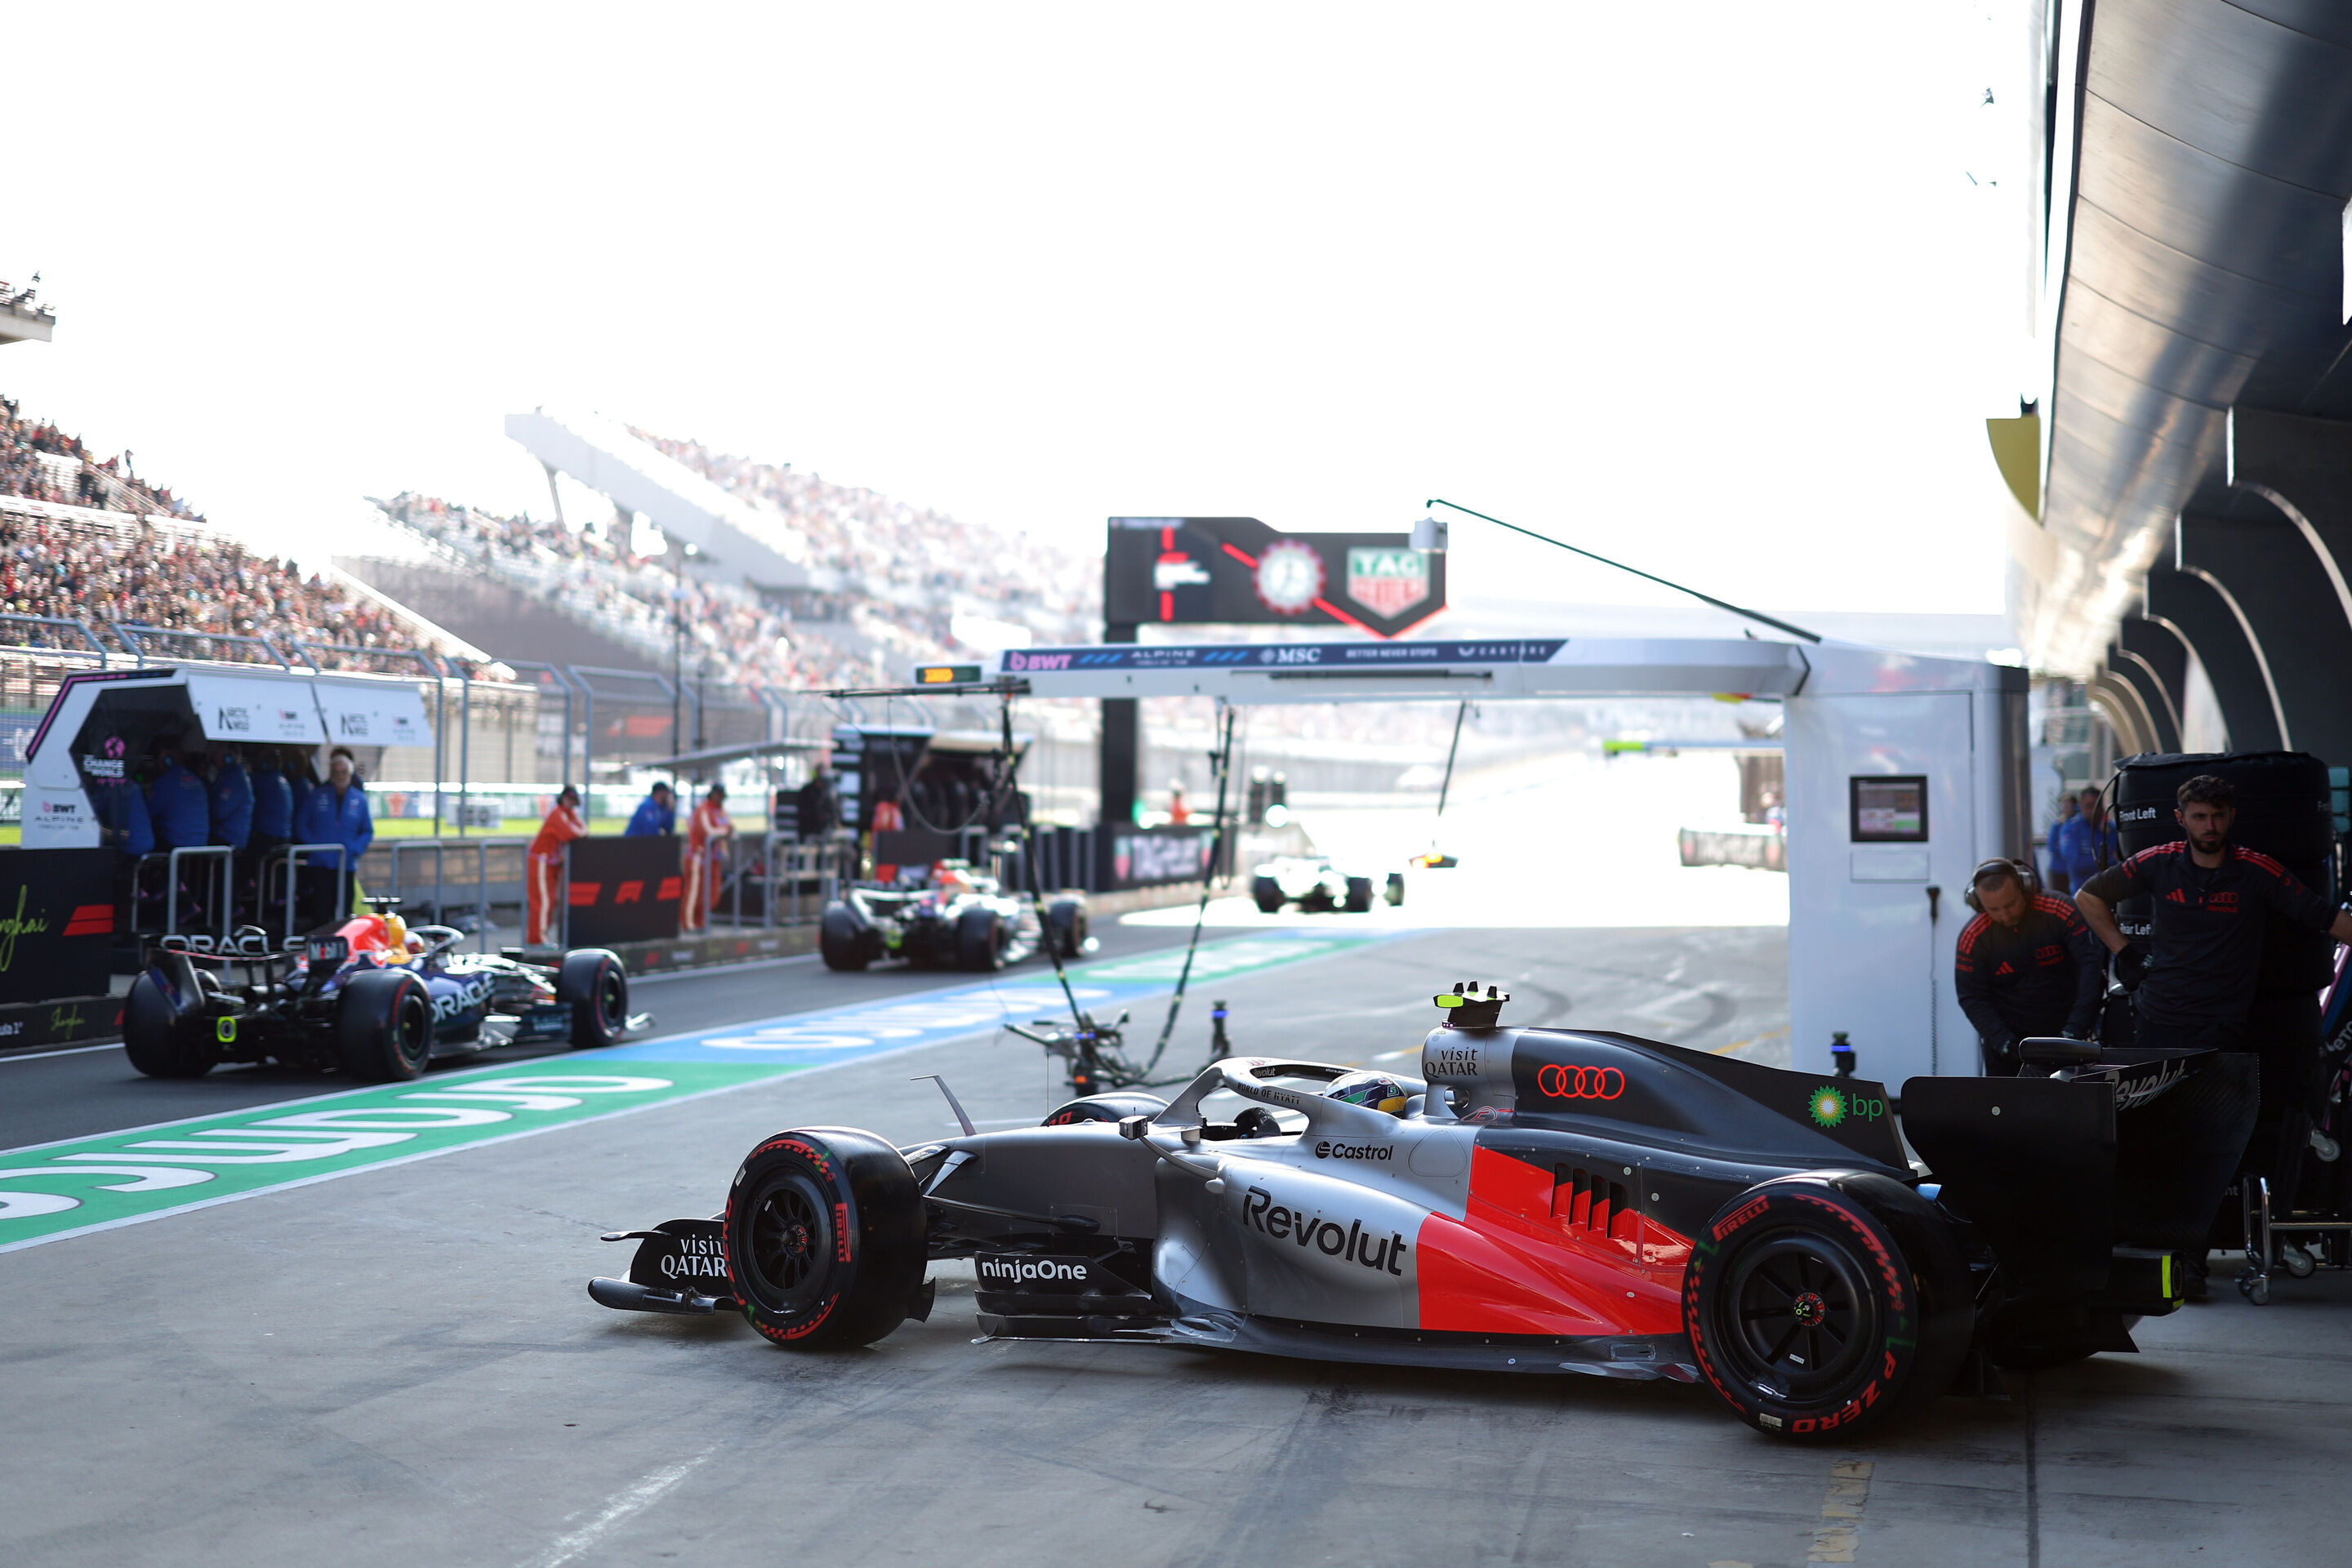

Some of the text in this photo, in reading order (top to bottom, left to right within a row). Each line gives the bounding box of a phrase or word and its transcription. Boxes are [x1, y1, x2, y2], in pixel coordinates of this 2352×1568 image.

[1131, 650, 1196, 658] ALPINE
[1276, 648, 1321, 663] MSC
[2136, 807, 2156, 819] Left
[160, 934, 305, 956] ORACLE
[1441, 1046, 1478, 1061] visit
[1424, 1062, 1478, 1078] QATAR
[1237, 1081, 1300, 1105] WORLD OF HYATT
[1852, 1093, 1884, 1123] bp
[1332, 1143, 1394, 1160] Castrol
[1712, 1194, 1771, 1242] PIRELLI
[835, 1202, 852, 1263] PIRELLI
[1241, 1185, 1408, 1277] Revolut
[661, 1254, 728, 1280] QATAR
[982, 1258, 1087, 1284] ninjaOne
[1883, 1350, 1896, 1379] P
[1792, 1379, 1881, 1432] ZERO
